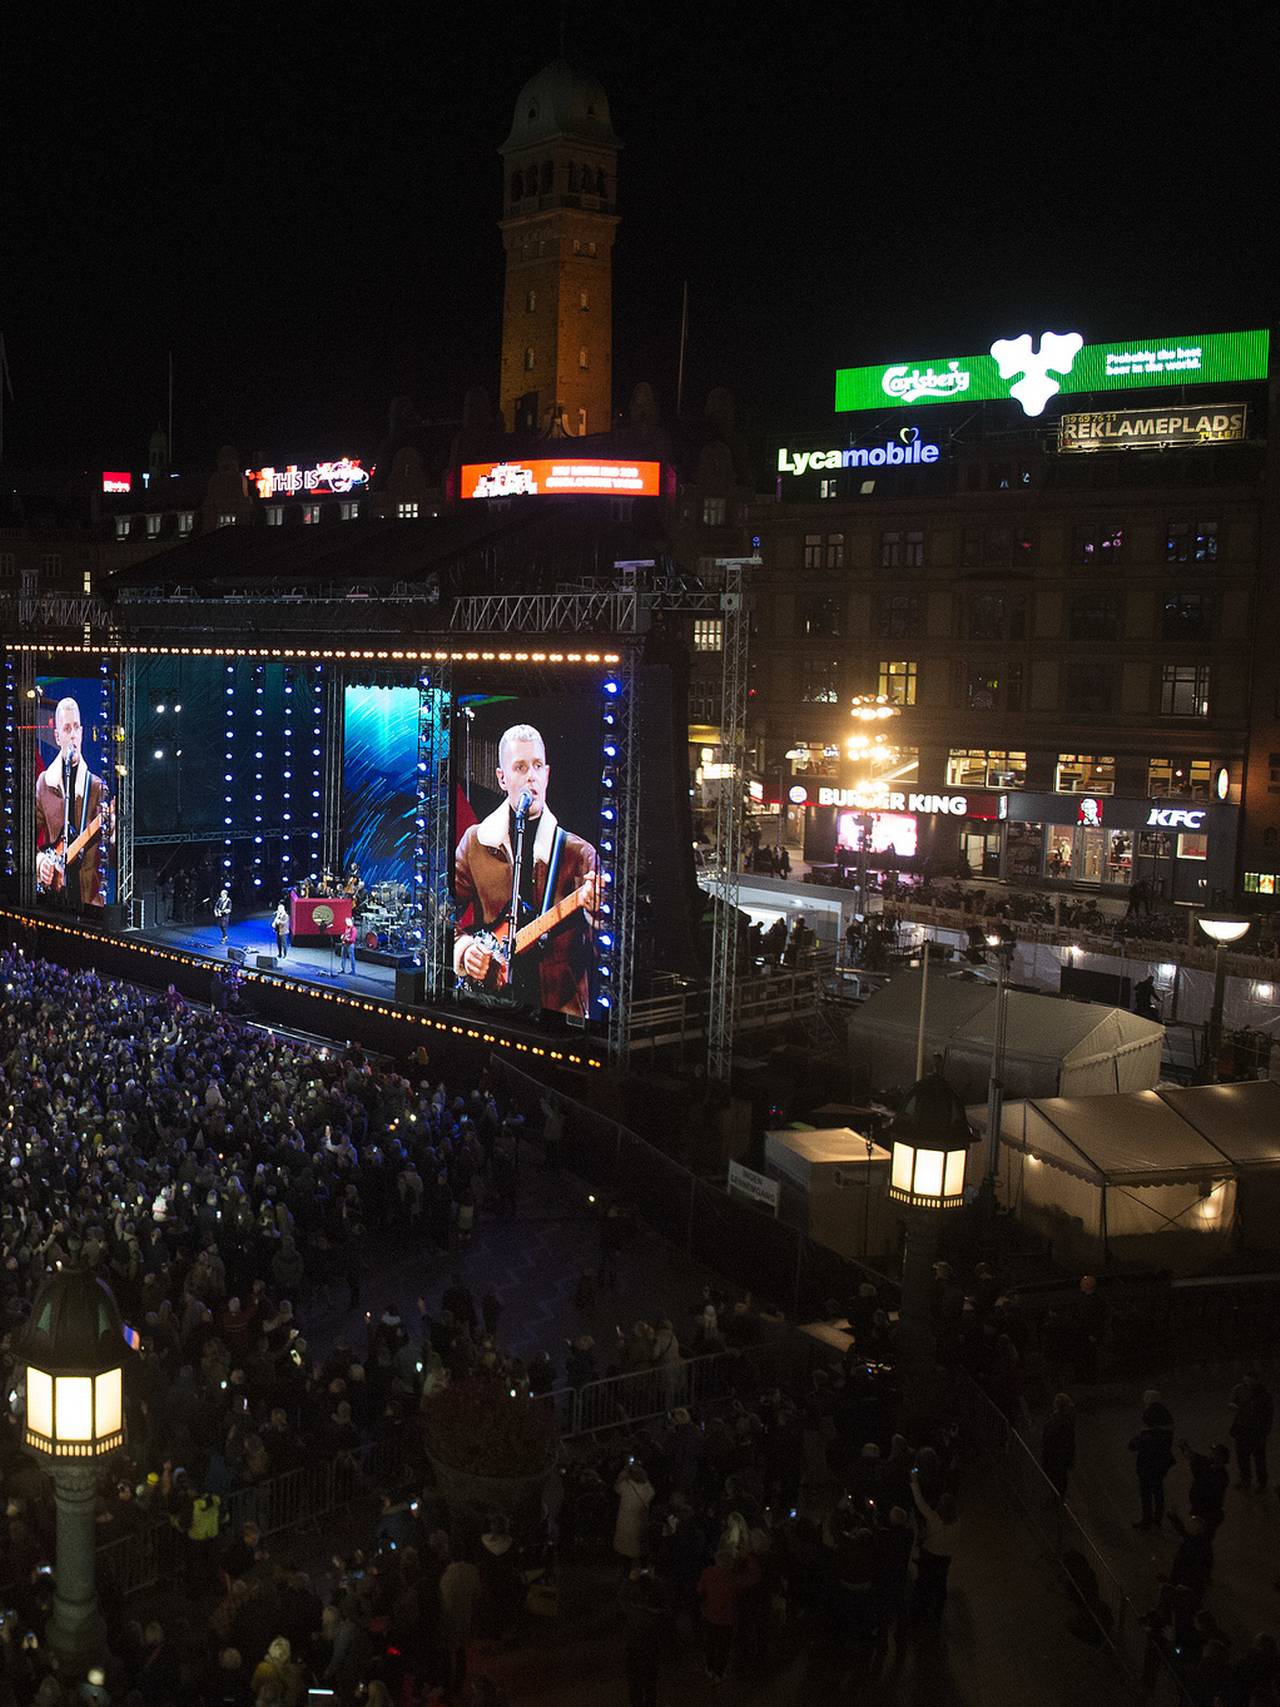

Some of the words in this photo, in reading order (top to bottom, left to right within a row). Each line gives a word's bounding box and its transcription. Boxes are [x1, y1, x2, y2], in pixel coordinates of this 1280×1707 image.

[882, 362, 970, 402] Carlsberg
[1064, 415, 1242, 439] REKLAMEPLADS
[778, 439, 940, 476] Lycamobile
[272, 470, 303, 492] THIS
[304, 470, 320, 490] IS
[908, 793, 967, 816] KING
[1147, 808, 1208, 829] KFC
